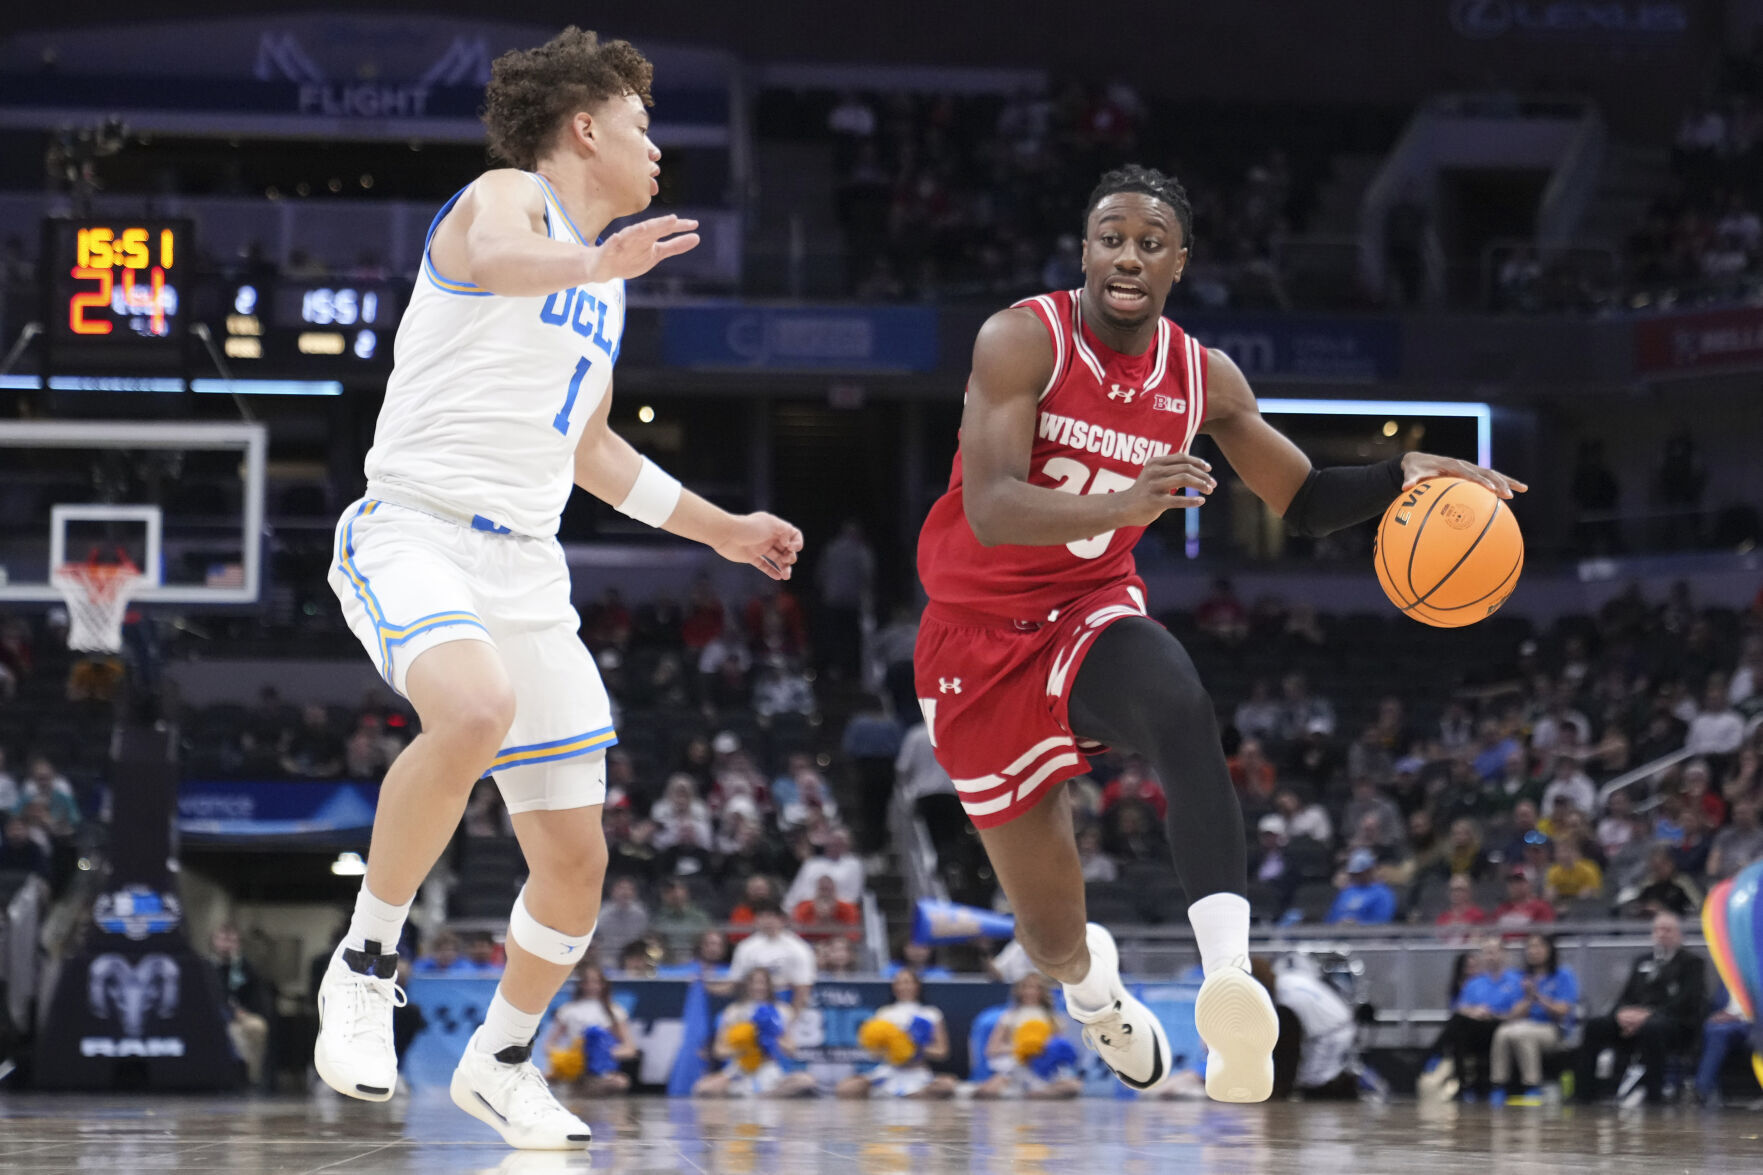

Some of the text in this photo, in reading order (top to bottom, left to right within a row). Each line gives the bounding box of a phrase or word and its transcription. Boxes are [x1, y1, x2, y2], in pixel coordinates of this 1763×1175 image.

[299, 86, 428, 116] FLIGHT
[77, 227, 174, 270] 15:51
[69, 265, 166, 335] 24
[540, 286, 620, 367] UCL
[552, 356, 592, 436] 1
[1039, 411, 1173, 467] WISCONSIN
[80, 1036, 185, 1057] RAM
